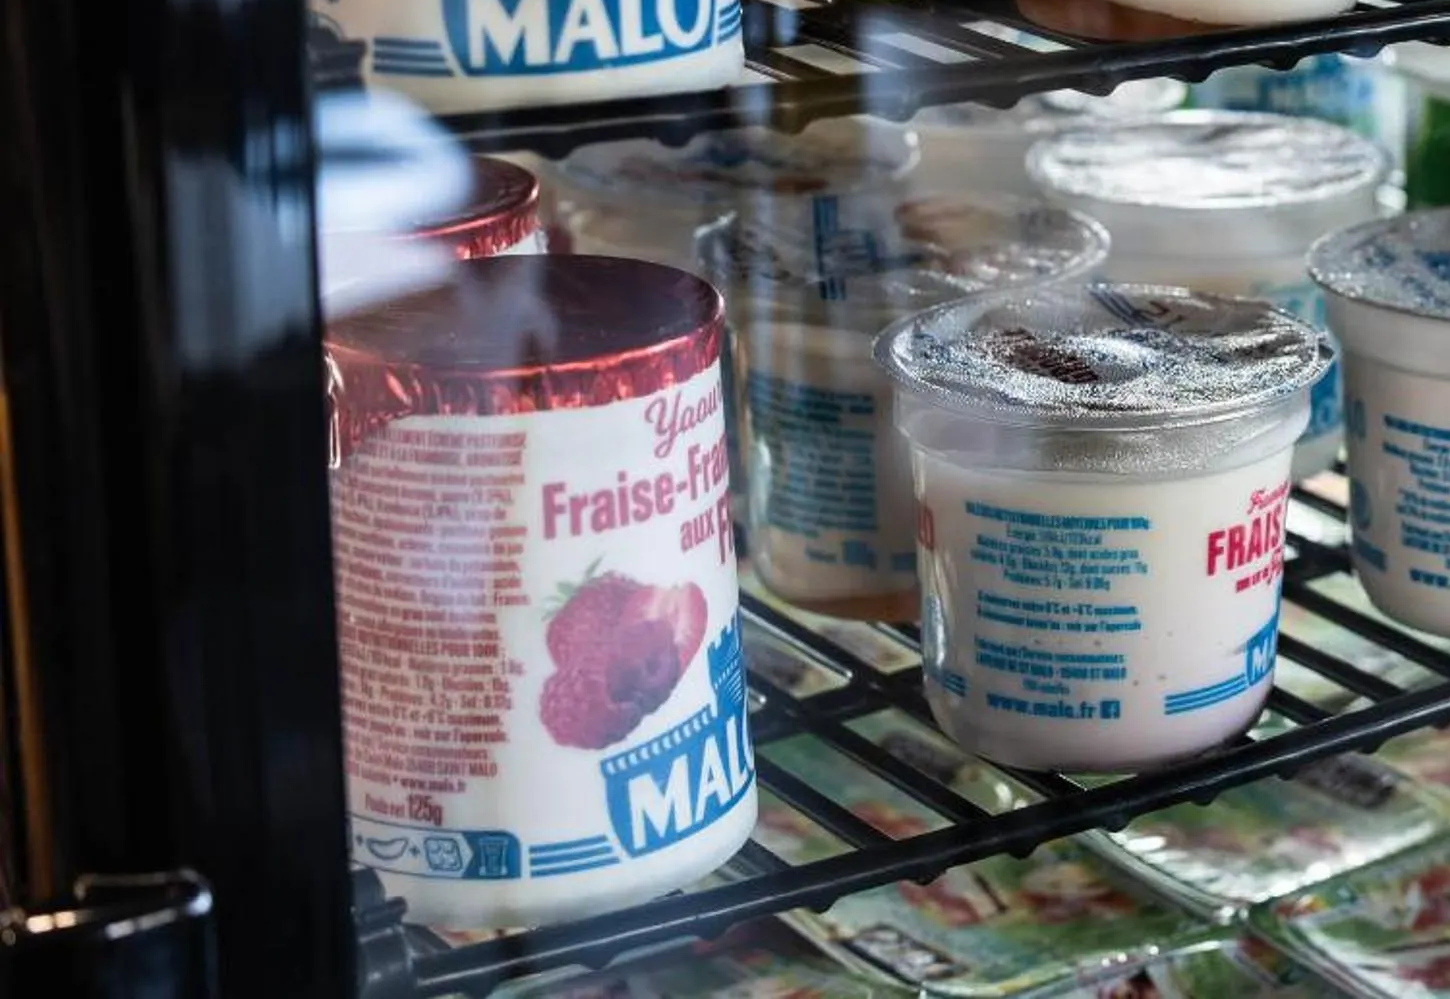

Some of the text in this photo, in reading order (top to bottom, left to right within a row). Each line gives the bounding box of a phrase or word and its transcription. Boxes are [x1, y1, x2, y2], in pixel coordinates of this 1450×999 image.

[644, 376, 724, 459] Yaou
[541, 433, 729, 540] Fraise-Fra
[680, 507, 715, 553] aux
[1207, 505, 1283, 577] FRAIS
[408, 793, 444, 827] 125g
[628, 715, 752, 848] MAL
